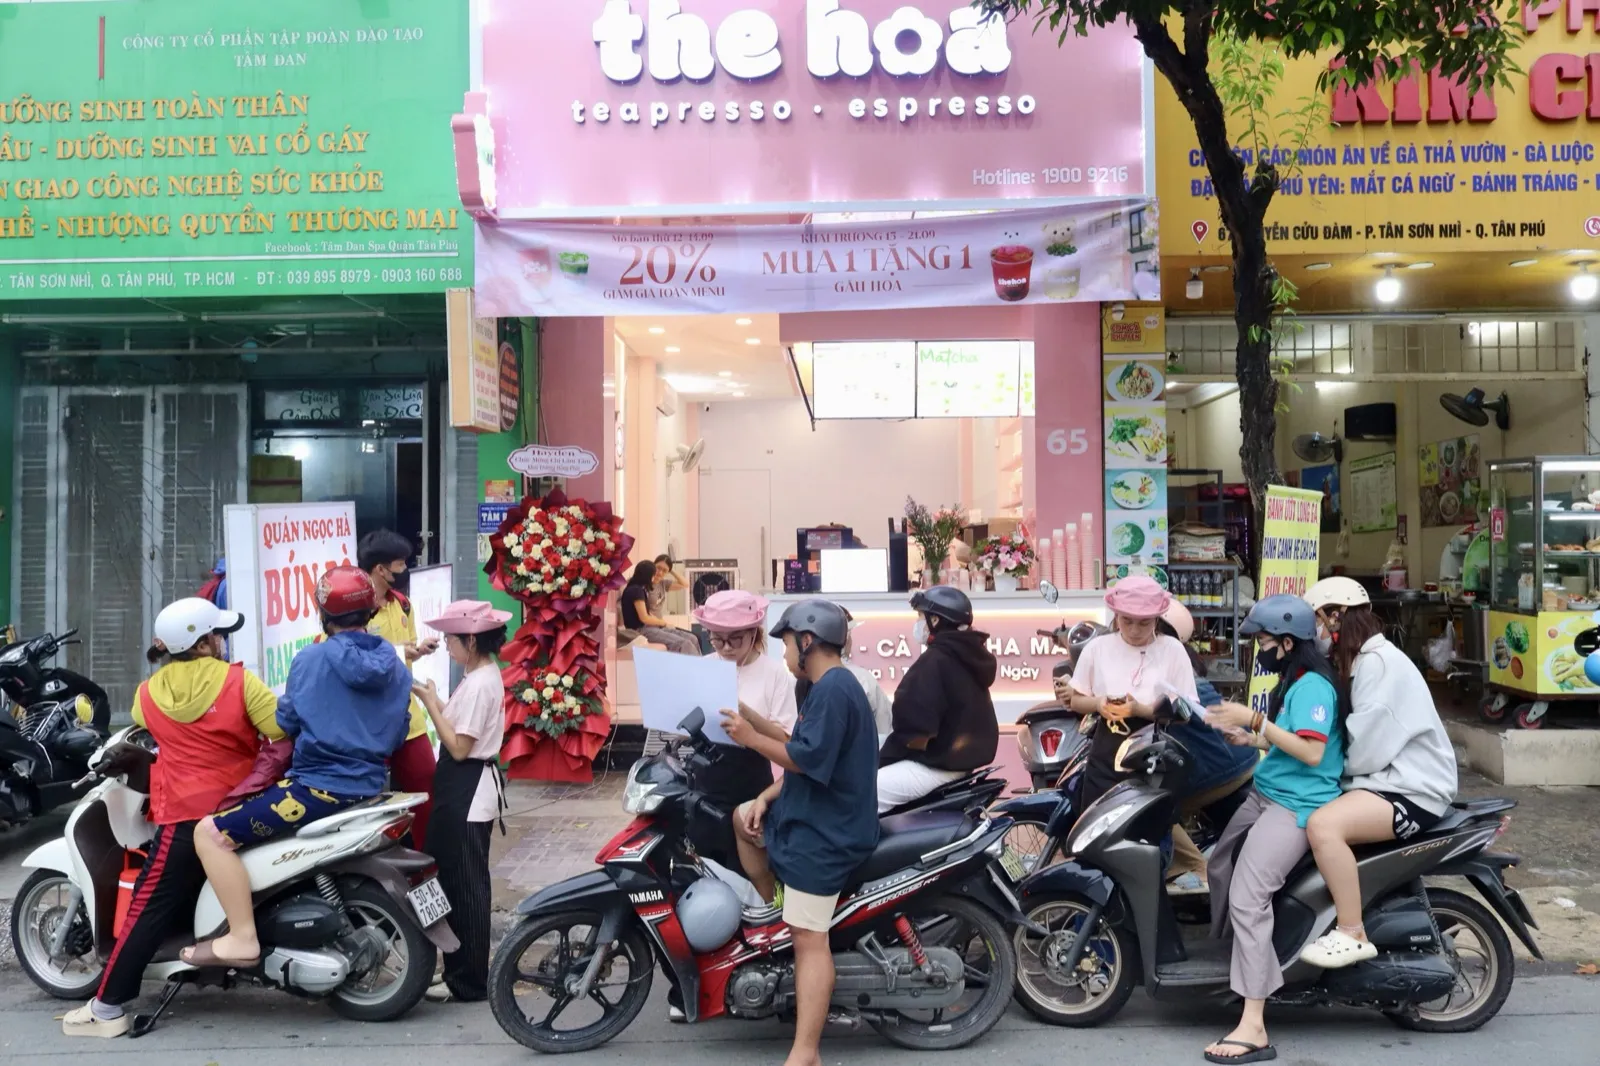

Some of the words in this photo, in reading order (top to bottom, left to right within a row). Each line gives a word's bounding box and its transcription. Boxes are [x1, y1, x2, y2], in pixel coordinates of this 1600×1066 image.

[122, 33, 164, 50] CÔNG
[169, 34, 189, 48] TY
[269, 28, 301, 46] TẬP
[306, 28, 350, 44] ĐOÀN
[356, 26, 388, 43] ĐÀO
[392, 26, 424, 44] TẠO
[592, 0, 782, 81] the
[805, 0, 1012, 77] hoa
[234, 51, 267, 67] TÂM
[275, 52, 307, 67] ĐAN
[1328, 55, 1497, 122] KIM
[1528, 53, 1600, 121] C
[79, 99, 146, 122] SINH
[152, 90, 225, 119] TOÀN
[232, 88, 309, 117] THÂN
[571, 99, 793, 127] teapresso
[848, 94, 1036, 122] espresso
[56, 131, 145, 159] DƯỠNG
[151, 134, 217, 157] SINH
[227, 134, 268, 155] VAI
[275, 122, 311, 154] CỔ
[317, 124, 369, 153] GÁY
[1260, 143, 1293, 166] CÁC
[1297, 144, 1337, 166] MÓN
[1342, 145, 1368, 166] ĂN
[1370, 140, 1391, 165] VỀ
[1396, 142, 1419, 164] GÀ
[1423, 139, 1456, 164] THẢ
[1460, 140, 1507, 163] VƯỜN
[1524, 141, 1548, 162] GÀ
[1551, 140, 1594, 165] LUỘC
[14, 177, 80, 200] GIAO
[86, 171, 161, 199] CÔNG
[168, 167, 243, 201] NGHỆ
[250, 166, 301, 195] SỨC
[309, 163, 384, 194] KHỎE
[972, 168, 1036, 186] Hotline:
[1041, 167, 1082, 184] 1900
[1087, 165, 1129, 183] 9216
[1308, 174, 1346, 195] YÊN:
[1350, 170, 1387, 194] MẮT
[1391, 171, 1414, 194] CÁ
[1418, 173, 1456, 193] NGỪ
[1472, 171, 1518, 192] BÁNH
[1522, 169, 1578, 191] TRÁNG
[57, 211, 171, 242] NHƯỢNG
[179, 202, 275, 239] QUYỀN
[286, 206, 400, 233] THƯƠNG
[406, 207, 459, 234] MẠI
[1293, 220, 1319, 240] CỬU
[1322, 221, 1352, 240] ĐÀM
[1365, 224, 1377, 240] P.
[1379, 220, 1404, 239] TÂN
[1408, 222, 1435, 238] SƠN
[1439, 220, 1462, 238] NHÌ
[1475, 222, 1488, 239] Q.
[1491, 219, 1516, 237] TÂN
[1520, 219, 1546, 237] PHÚ
[265, 242, 312, 253] Facebook
[320, 241, 343, 252] Tâm
[368, 240, 386, 252] Spa
[389, 240, 415, 253] Quận
[417, 239, 437, 250] Tân
[439, 238, 459, 250] Phú
[800, 232, 830, 245] KHAI
[907, 229, 936, 241] 21.09
[619, 243, 717, 286] 20%
[761, 249, 838, 276] MUA
[844, 250, 859, 273] 1
[863, 243, 950, 277] TẶNG
[960, 243, 974, 270] 1
[9, 271, 35, 289] TÂN
[40, 270, 67, 288] SƠN
[70, 269, 94, 290] NHÌ,
[101, 274, 114, 287] Q.
[118, 270, 143, 287] TÂN
[206, 271, 235, 286] HCM
[287, 270, 310, 284] 039
[314, 270, 336, 284] 895
[340, 269, 371, 284] 8979
[381, 268, 412, 283] 0903
[416, 267, 436, 282] 160
[440, 267, 463, 282] 688
[691, 286, 726, 297] MENU
[920, 348, 980, 365] Matcha
[1045, 428, 1089, 456] 65
[481, 510, 500, 522] TÂM
[263, 515, 300, 549] QUÁN
[302, 517, 334, 545] NGỌC
[335, 512, 351, 537] HÀ
[264, 549, 319, 627] BÚN
[877, 634, 912, 658] CÀ
[1000, 661, 1040, 682] Ngày
[1401, 837, 1453, 857] VISION
[413, 880, 440, 906] 50-AC
[628, 889, 664, 903] YAMAHA
[419, 896, 450, 925] 780.58
